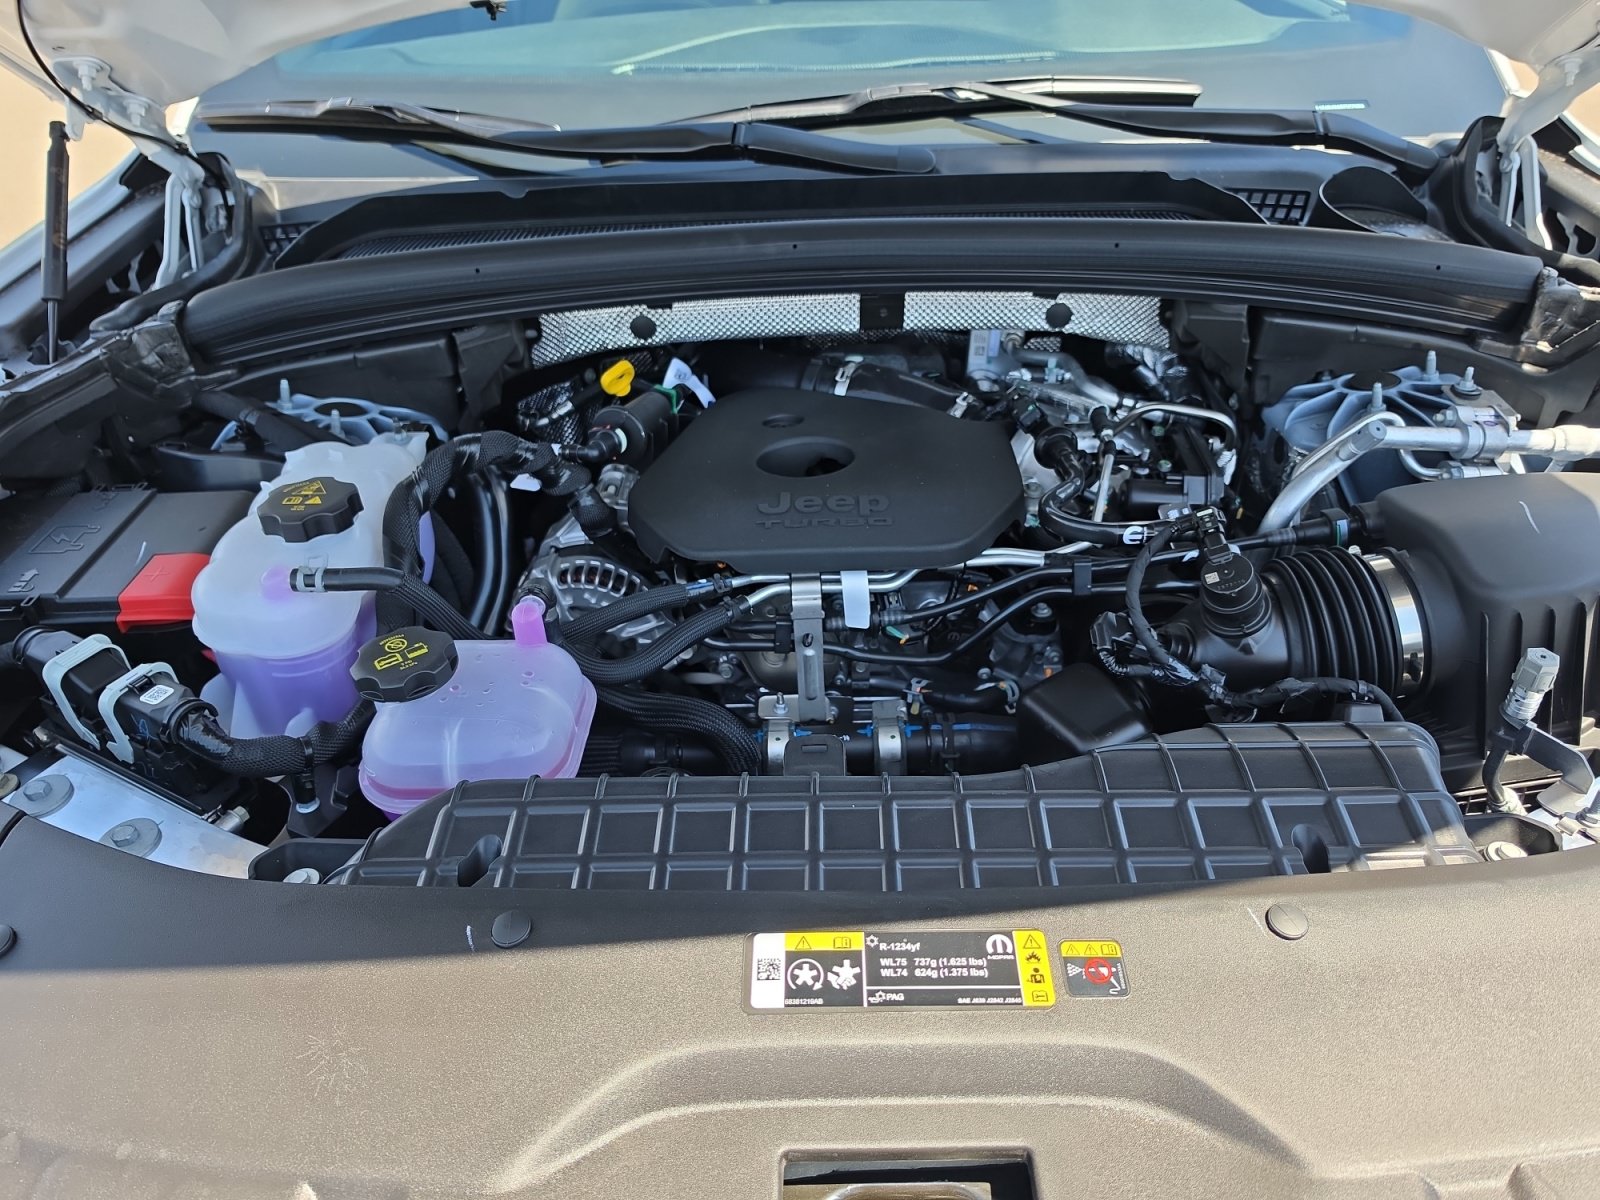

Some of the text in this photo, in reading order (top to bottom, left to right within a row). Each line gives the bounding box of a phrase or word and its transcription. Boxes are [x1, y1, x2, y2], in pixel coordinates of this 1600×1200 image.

[757, 491, 889, 517] Jeep
[754, 517, 894, 529] TURBO
[880, 942, 921, 952] R-1234yf
[880, 957, 987, 968] WL75 737g (1.625 lbs)
[880, 968, 989, 978] WL74 624g (1.375 lbs)
[886, 992, 905, 1001] PAG
